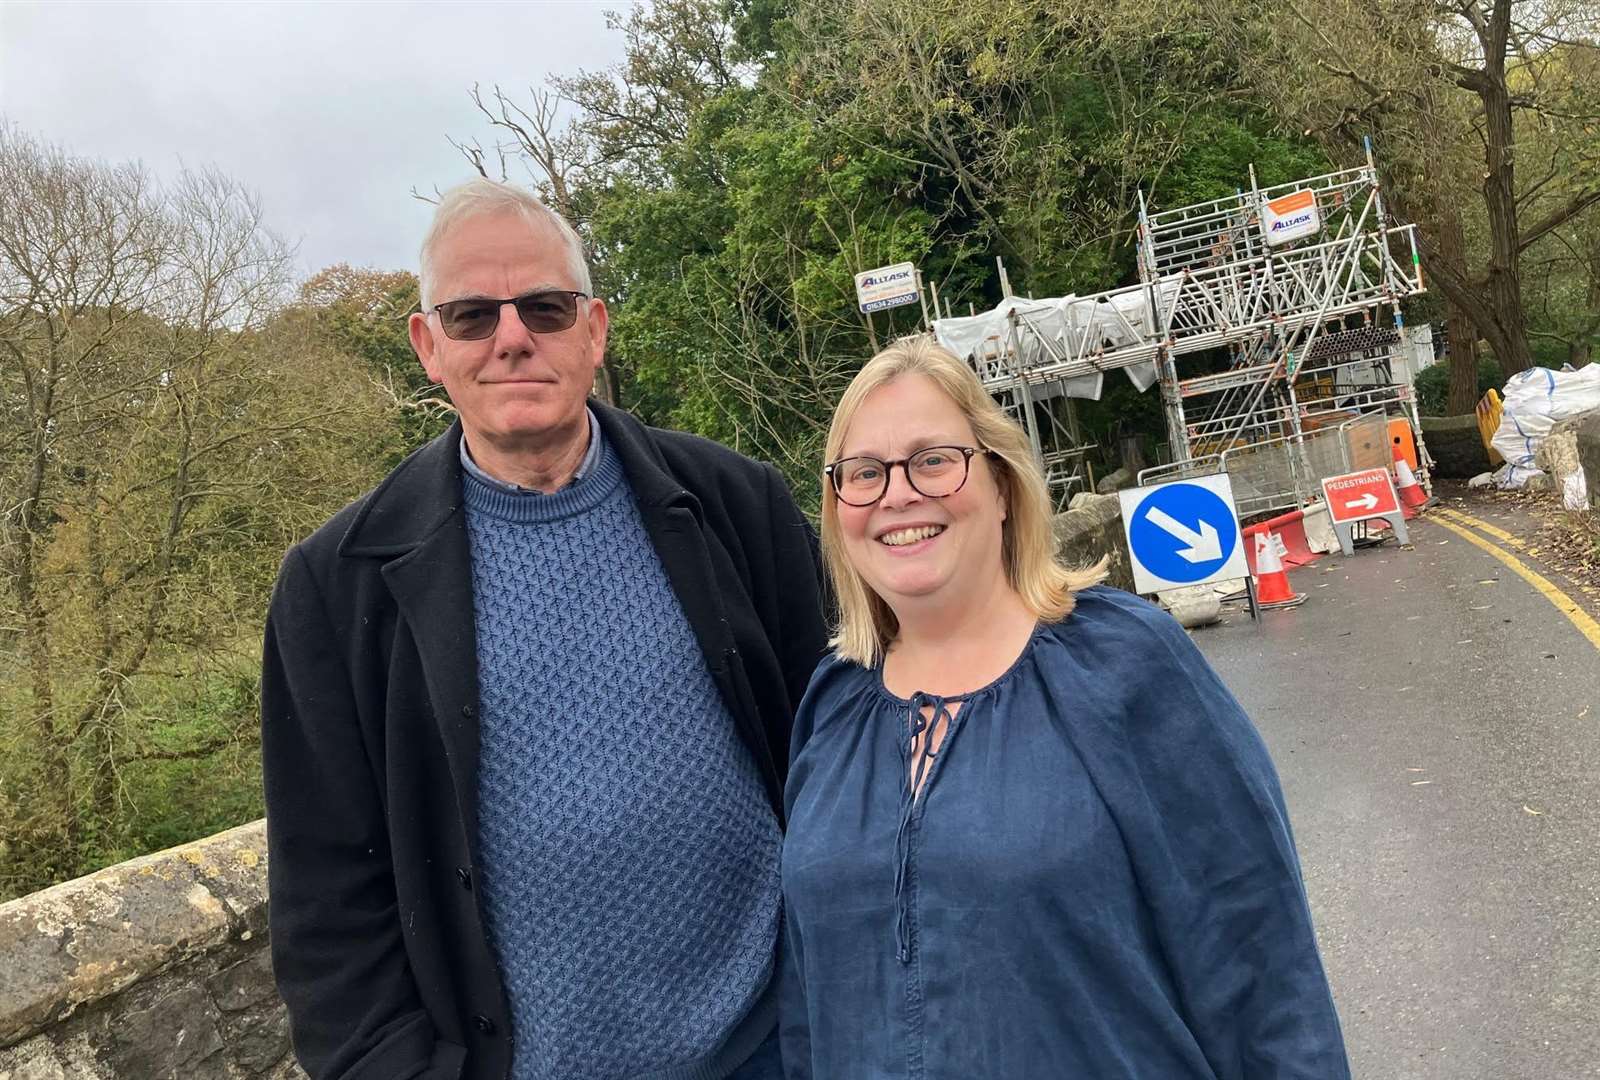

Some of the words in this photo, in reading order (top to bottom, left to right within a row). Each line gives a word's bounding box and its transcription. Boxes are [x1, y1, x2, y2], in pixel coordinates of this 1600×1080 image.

[1272, 214, 1311, 232] ALLTASK
[861, 271, 910, 288] ALLTASK
[1327, 474, 1385, 490] PEDESTRIANS
